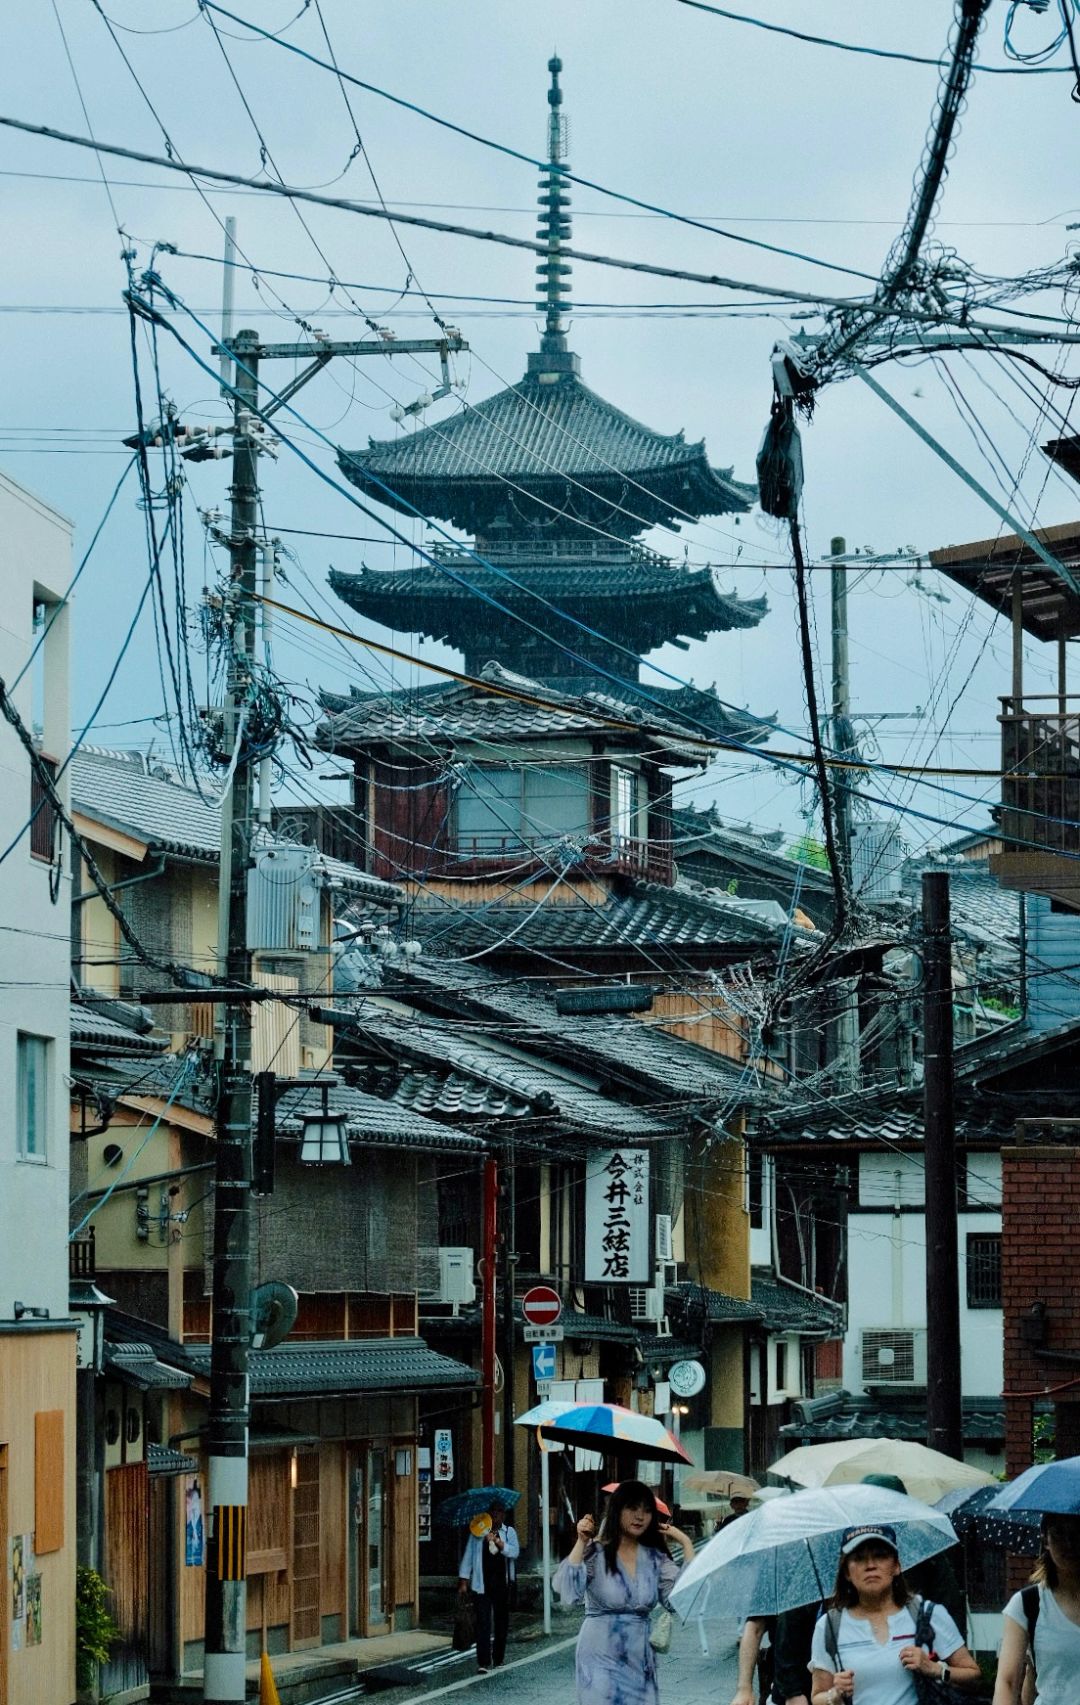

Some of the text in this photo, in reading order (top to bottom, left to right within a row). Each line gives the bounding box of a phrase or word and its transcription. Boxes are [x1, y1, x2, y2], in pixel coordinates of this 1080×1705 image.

[602, 1153, 632, 1278] 今井三絃店
[846, 1527, 883, 1540] PEANUTS
